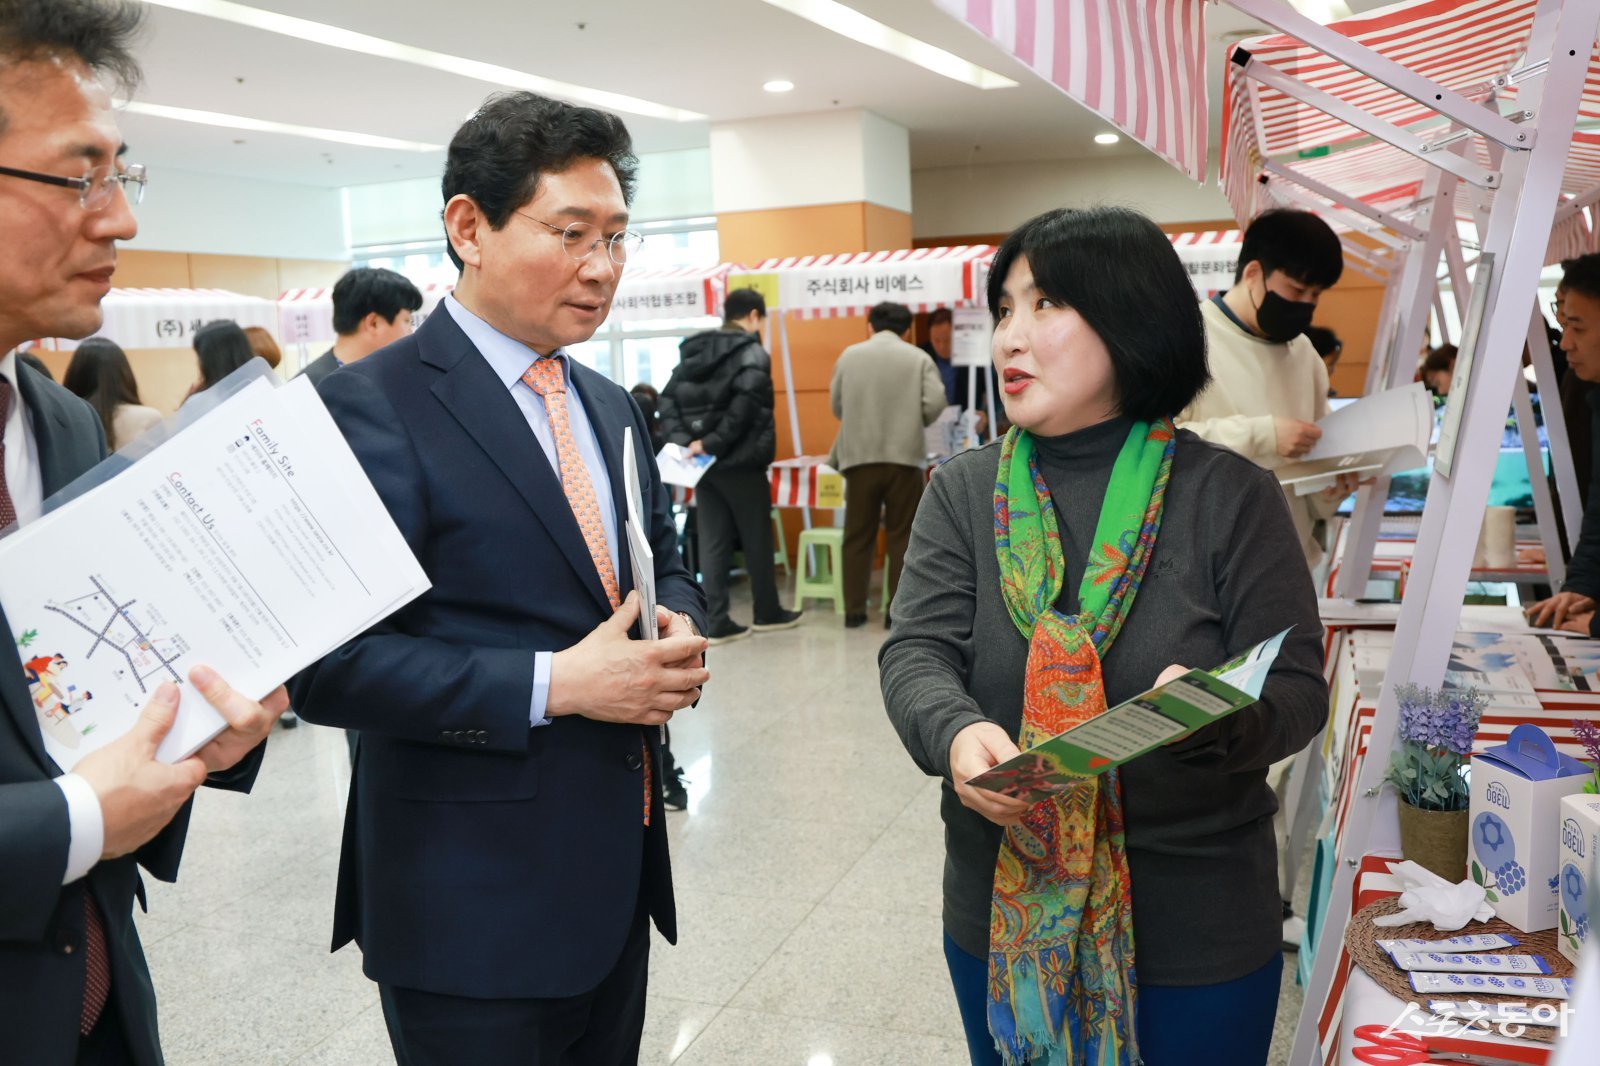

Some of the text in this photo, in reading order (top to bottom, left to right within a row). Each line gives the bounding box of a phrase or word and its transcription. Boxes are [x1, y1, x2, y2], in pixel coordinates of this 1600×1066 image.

[807, 274, 924, 296] 주식회사 비에스
[611, 292, 697, 309] 사회적협동조합
[156, 319, 184, 338] (주)
[250, 418, 279, 455] Family
[277, 455, 295, 477] Site
[170, 471, 216, 530] Contact Us
